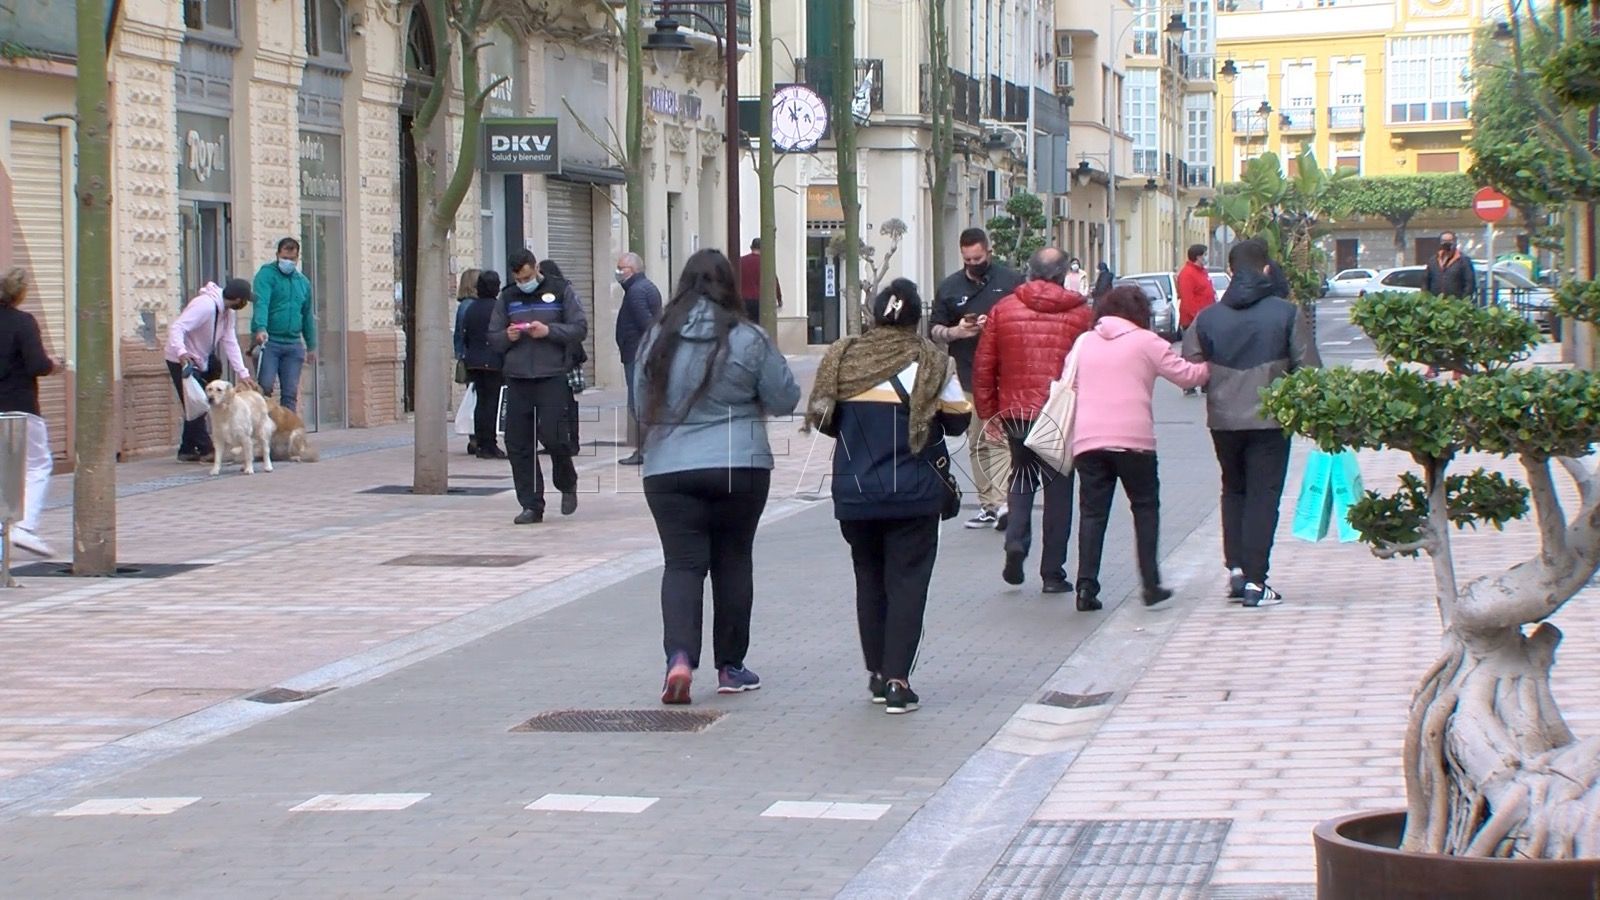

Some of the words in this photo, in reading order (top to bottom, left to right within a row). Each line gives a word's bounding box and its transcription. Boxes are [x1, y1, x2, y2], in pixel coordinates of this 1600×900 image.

[491, 135, 552, 152] DKV
[187, 129, 225, 182] Royal
[491, 153, 512, 161] Salud
[512, 155, 518, 163] y
[518, 153, 552, 161] bienestar
